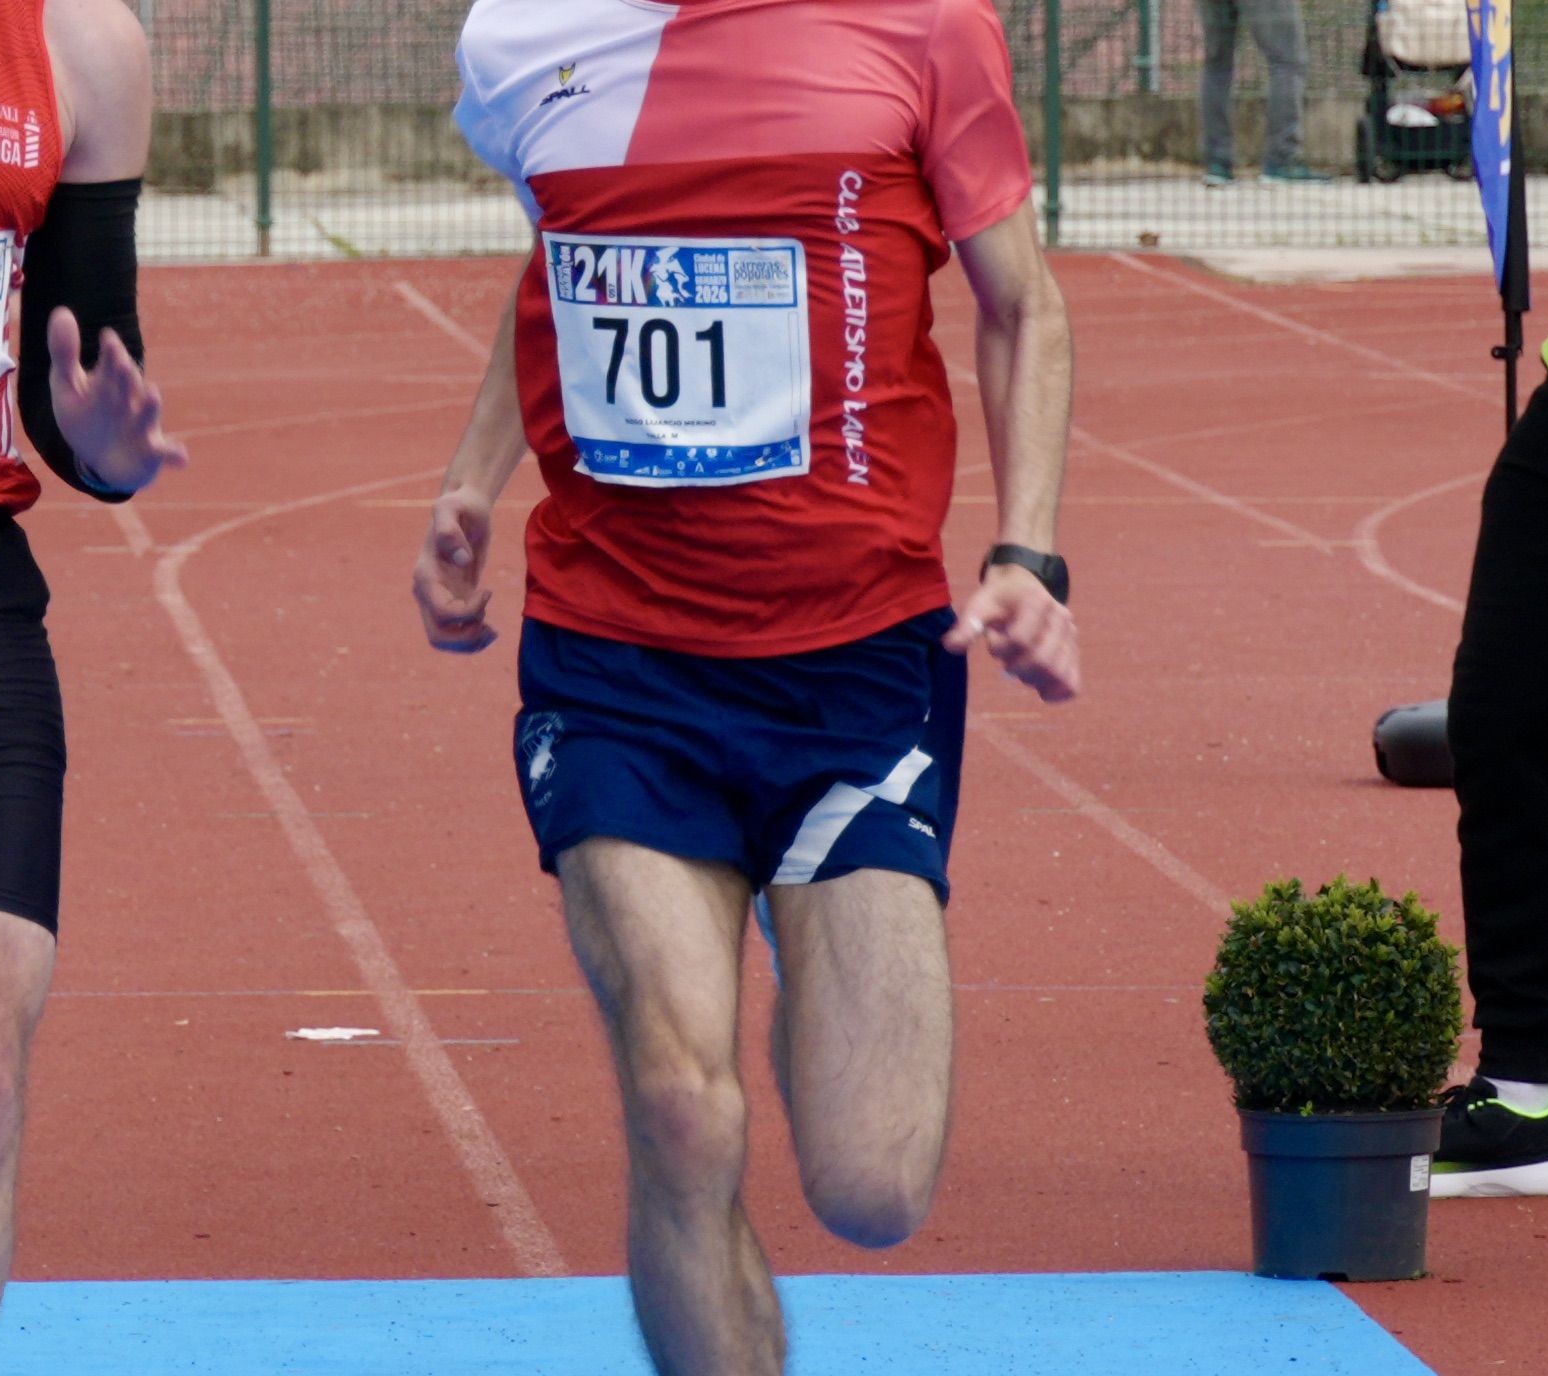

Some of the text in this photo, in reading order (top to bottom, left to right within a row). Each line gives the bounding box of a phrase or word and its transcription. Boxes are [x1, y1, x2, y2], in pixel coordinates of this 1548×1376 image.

[835, 170, 862, 235] CLUB
[574, 245, 648, 305] 21K
[695, 285, 728, 304] 2026
[840, 242, 868, 392] ATLETISMO
[592, 316, 727, 409] 701
